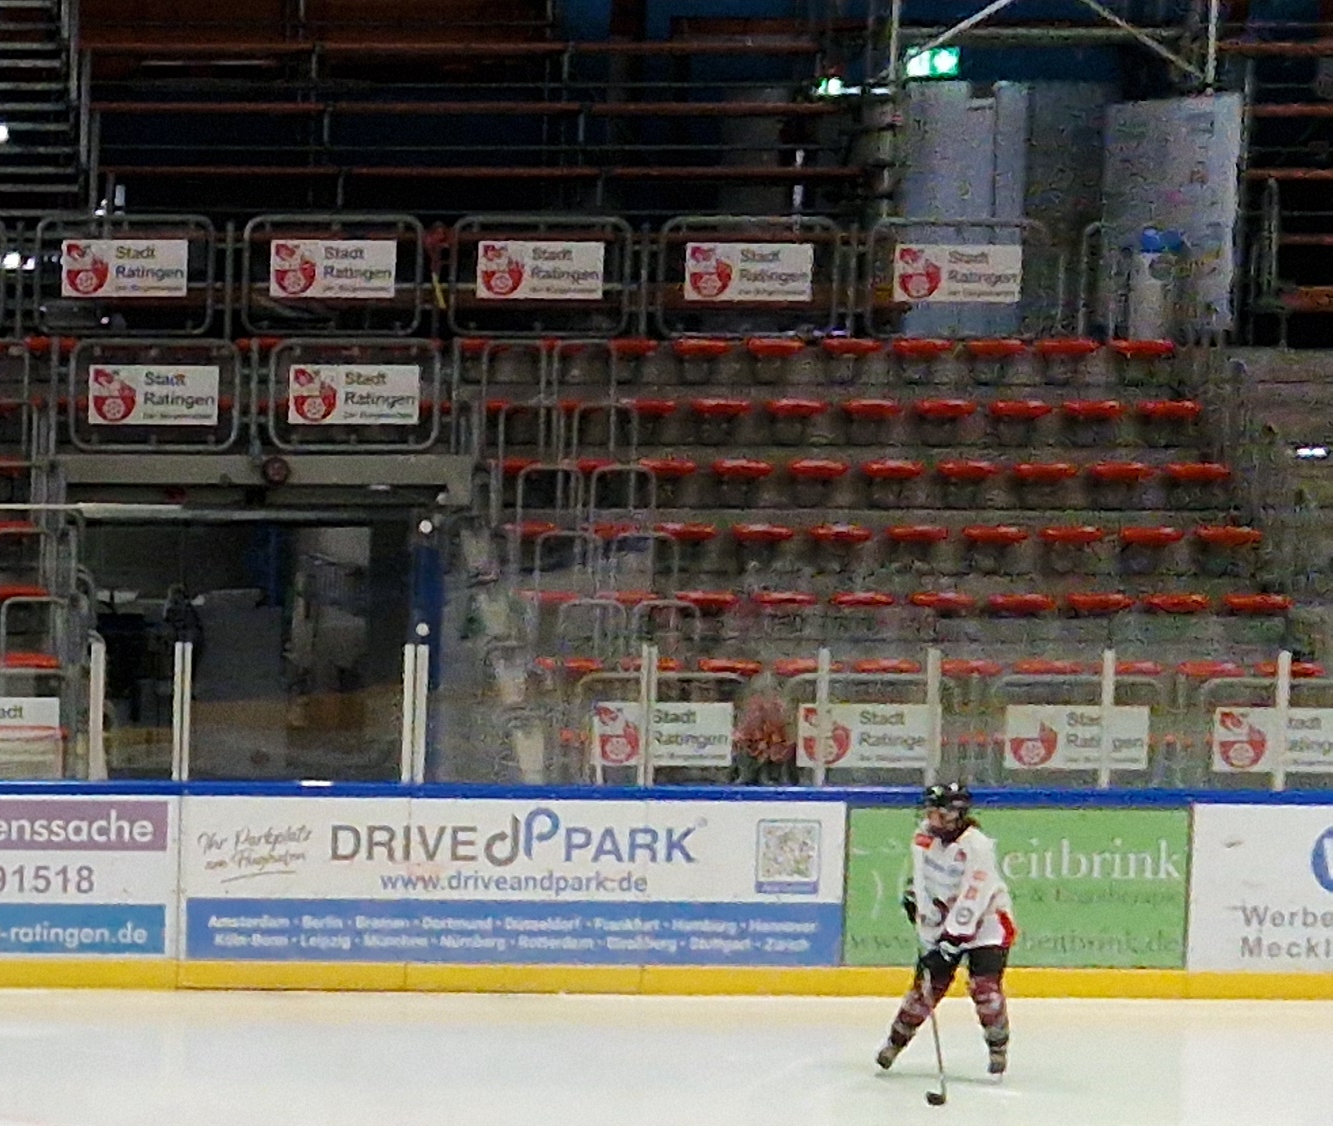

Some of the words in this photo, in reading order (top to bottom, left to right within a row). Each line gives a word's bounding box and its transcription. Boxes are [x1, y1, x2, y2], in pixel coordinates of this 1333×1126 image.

[115, 245, 156, 259] Stadt
[323, 246, 364, 259] Stadt
[115, 265, 184, 283] Ratingen
[323, 265, 393, 283] Ratingen
[144, 371, 186, 387] Stadt
[345, 372, 387, 386] Stadt
[144, 391, 215, 409] Ratingen
[344, 391, 415, 409] Ratingen
[1066, 711, 1102, 728] Sta
[859, 730, 927, 750] Ratinge
[331, 824, 478, 861] DRIVE
[563, 825, 697, 864] PARK
[1001, 837, 1181, 880] eitbrink
[380, 871, 648, 896] www.driveandpark.de
[1242, 905, 1333, 927] Werbe
